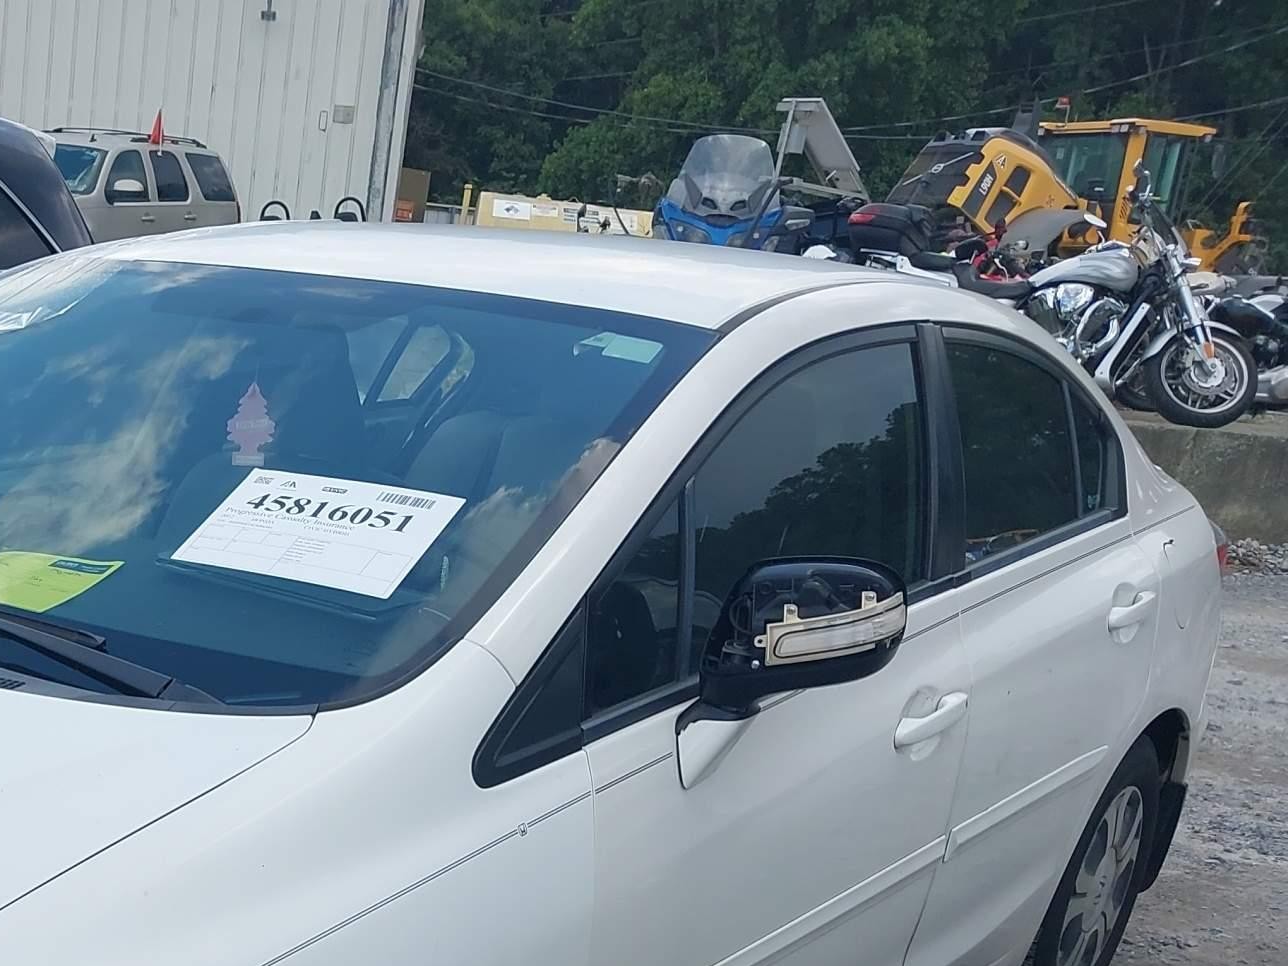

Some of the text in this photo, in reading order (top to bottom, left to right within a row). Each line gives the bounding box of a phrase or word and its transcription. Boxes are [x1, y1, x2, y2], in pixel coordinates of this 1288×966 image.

[979, 173, 994, 195] L90H
[226, 507, 274, 519] Progressive
[275, 513, 312, 525] Casualty
[314, 519, 354, 531] Insurance
[246, 493, 414, 534] 45816051
